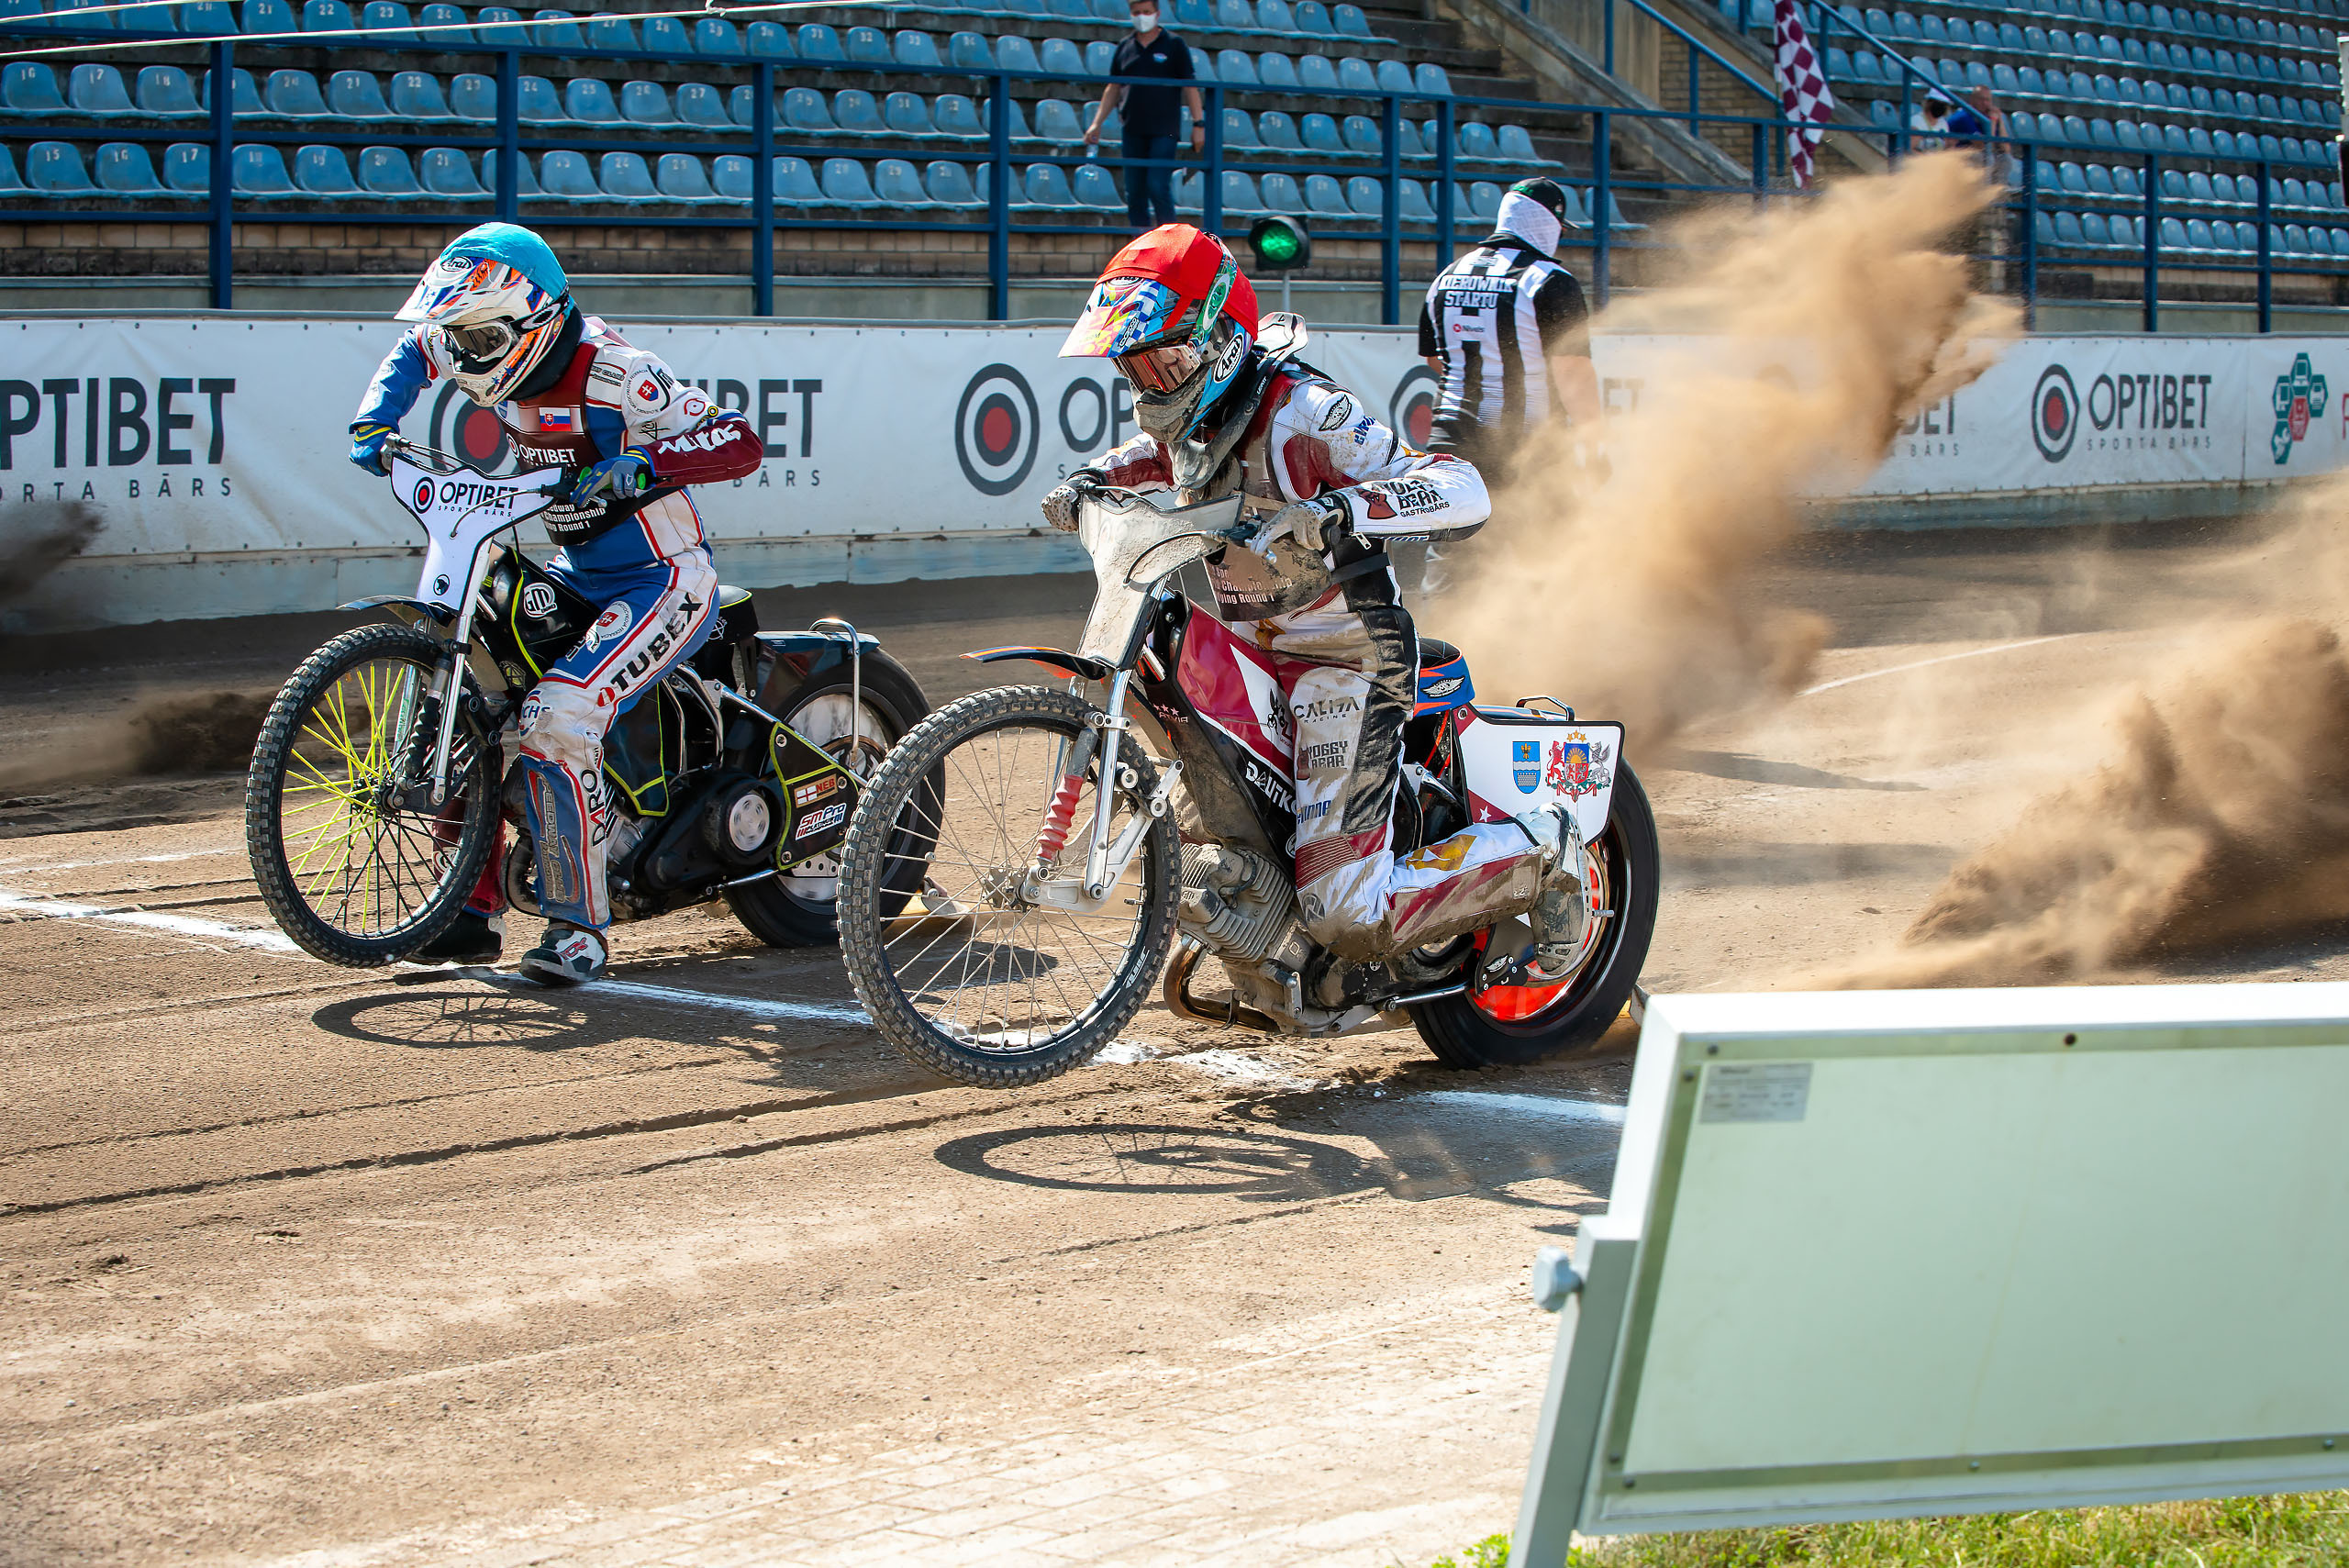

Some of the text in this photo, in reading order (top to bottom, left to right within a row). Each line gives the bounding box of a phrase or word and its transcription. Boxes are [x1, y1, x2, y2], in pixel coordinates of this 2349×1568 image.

[319, 5, 334, 16] 22
[380, 7, 394, 18] 23
[21, 67, 36, 81] 16
[90, 69, 105, 83] 17
[407, 76, 422, 87] 22
[47, 150, 60, 162] 15
[183, 149, 198, 162] 17
[1444, 291, 1500, 308] STARTU
[1219, 338, 1243, 380] Arai
[2088, 373, 2212, 431] OPTIBET
[518, 444, 576, 464] OPTIBET
[0, 473, 231, 502] RTA BĀRS
[440, 482, 518, 509] OPTIBET
[484, 508, 512, 517] BĀRS
[545, 507, 607, 523] Championship
[558, 521, 581, 532] Round
[585, 520, 591, 528] 1
[1239, 593, 1268, 605] Round
[610, 592, 704, 692] TUBEX
[1308, 740, 1349, 760] YOGGY
[581, 769, 607, 848] DARO
